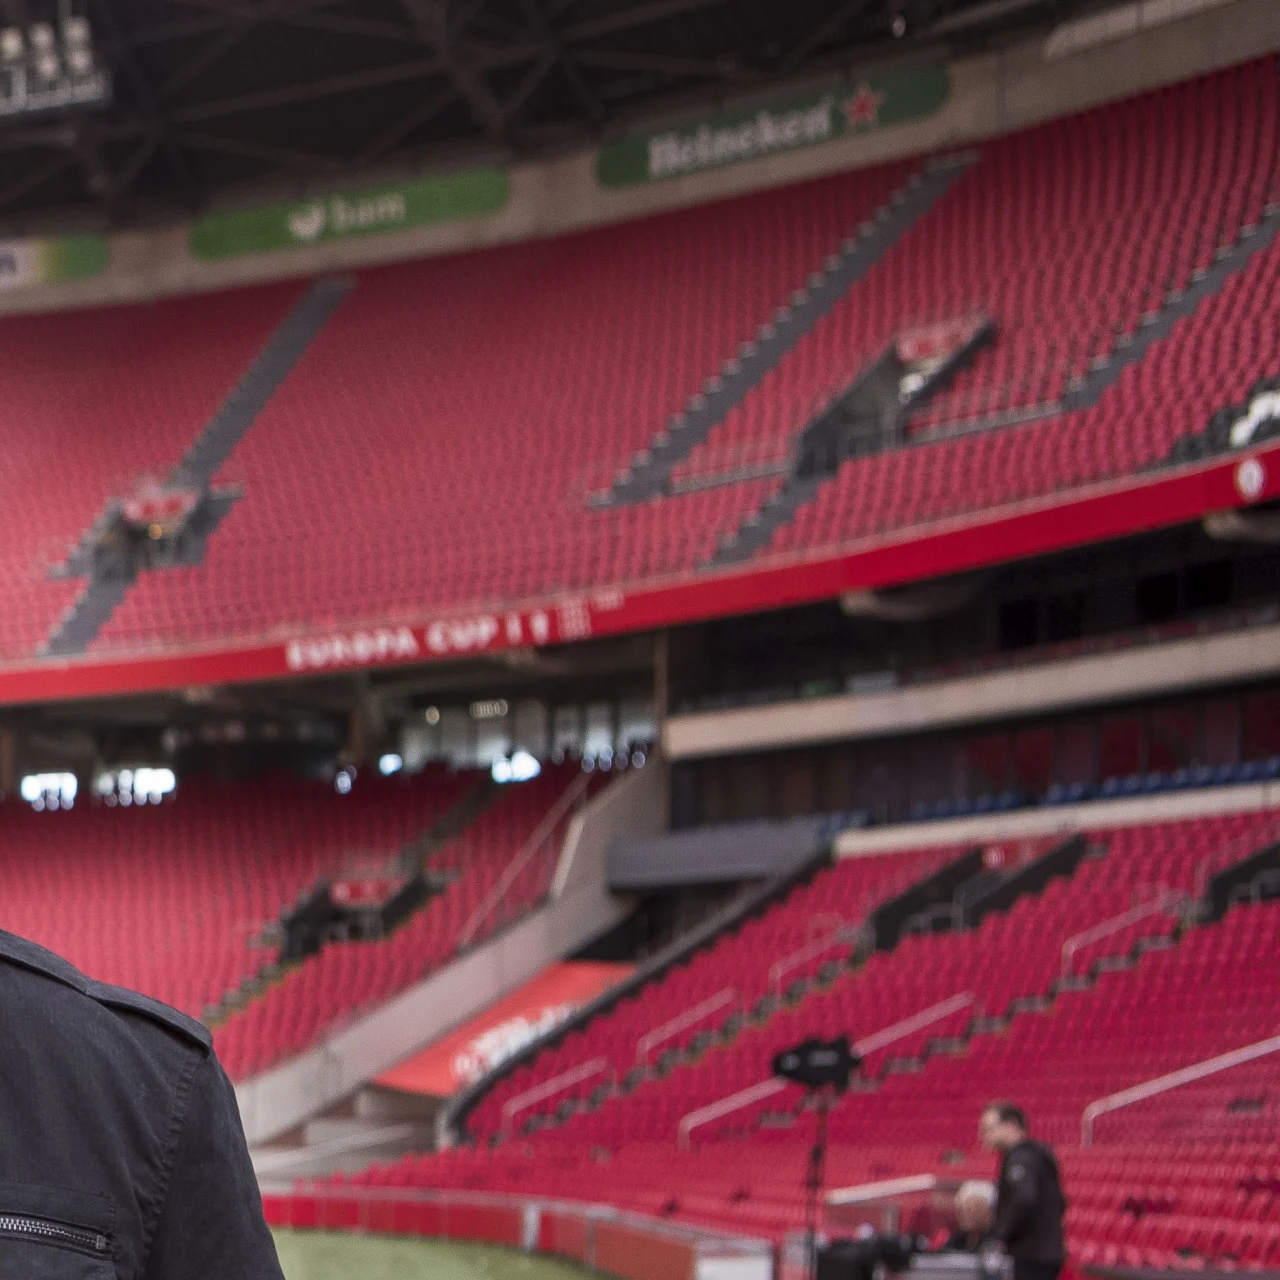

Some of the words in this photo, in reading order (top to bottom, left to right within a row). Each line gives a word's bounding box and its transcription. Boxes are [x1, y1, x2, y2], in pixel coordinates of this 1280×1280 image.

[648, 97, 834, 179] Heineken
[330, 193, 407, 232] bam
[286, 625, 420, 671] EUROPA
[425, 614, 499, 653] CUP
